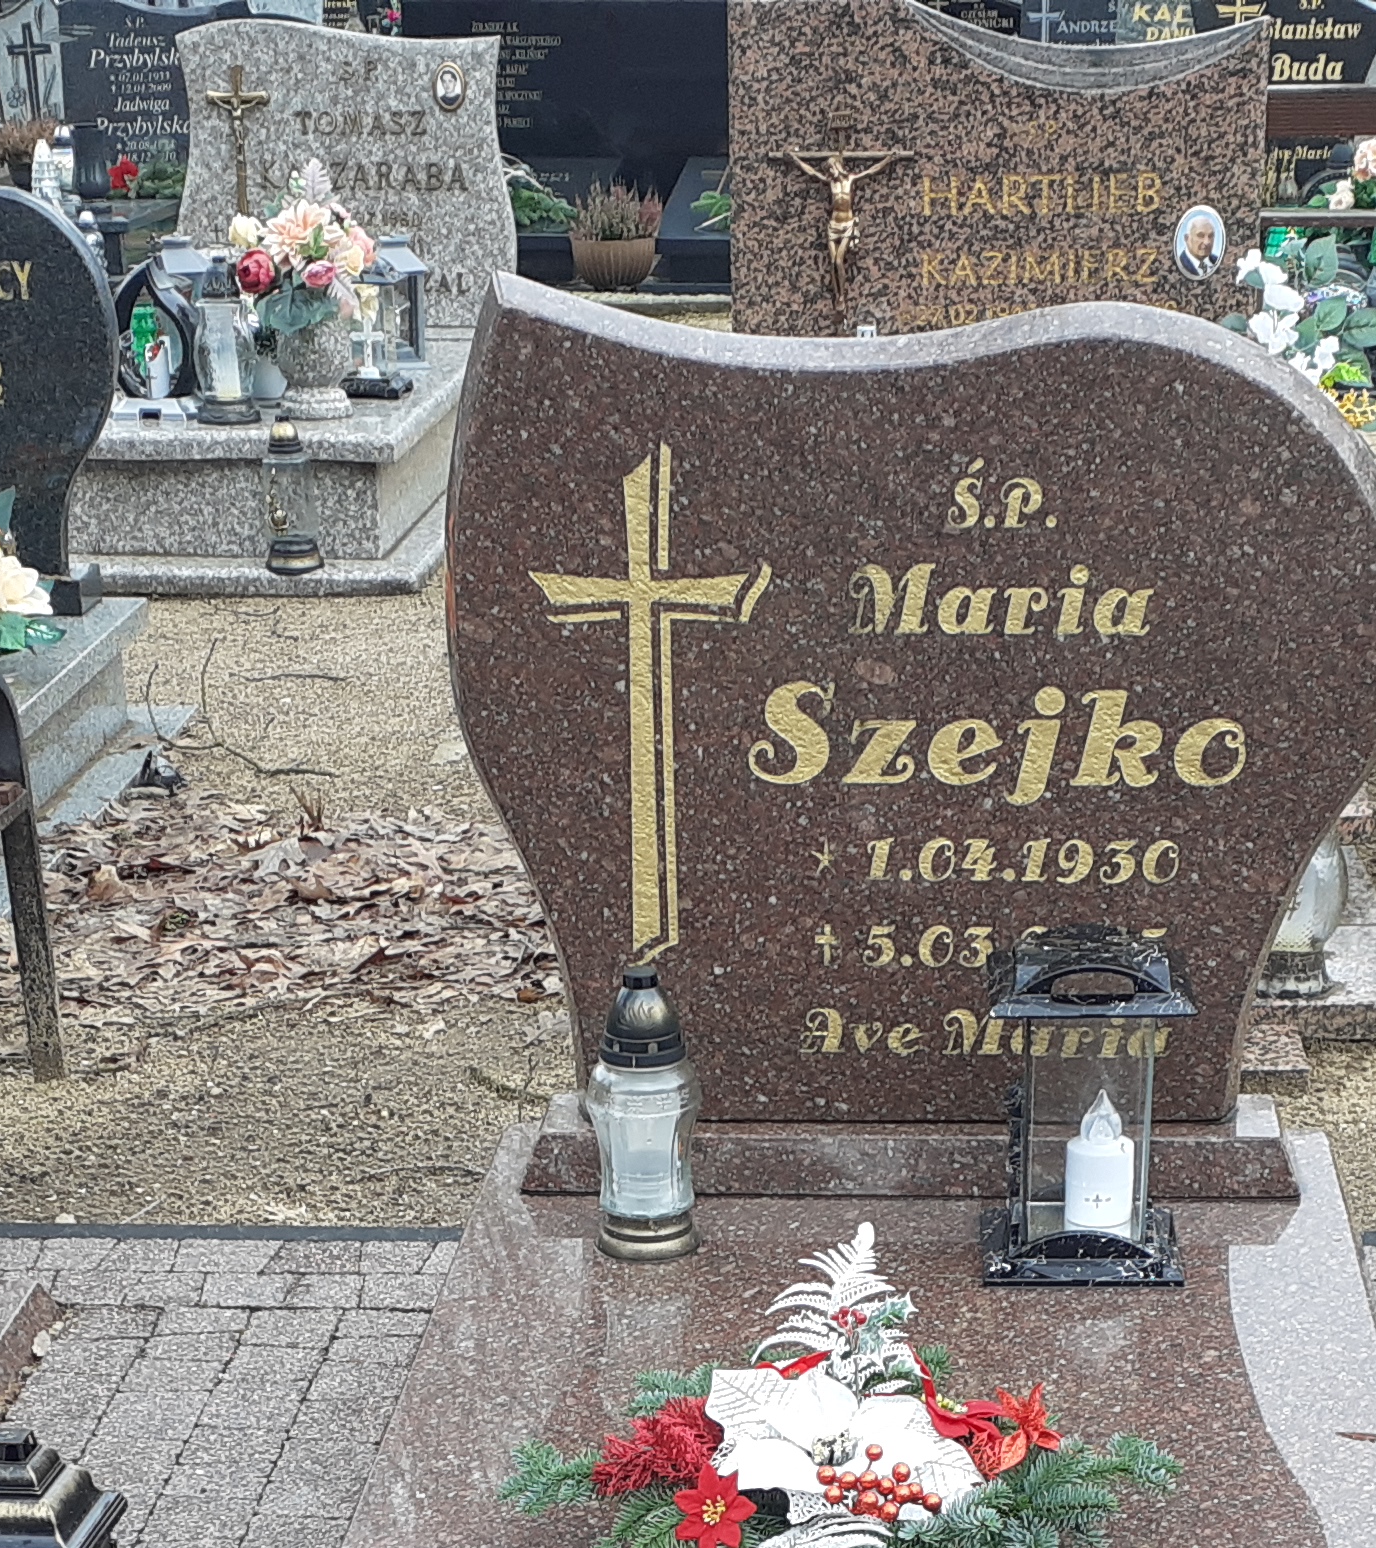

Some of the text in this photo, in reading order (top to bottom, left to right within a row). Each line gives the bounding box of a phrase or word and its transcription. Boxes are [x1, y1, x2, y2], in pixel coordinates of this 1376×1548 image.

[105, 31, 167, 49] Tadeusz
[1269, 16, 1363, 40] tanisław
[87, 47, 181, 72] Przybylsk
[1271, 52, 1345, 82] Buda
[112, 95, 171, 114] Jadwiga
[292, 109, 428, 137] TOMASZ
[260, 160, 470, 192] KZARABA
[922, 171, 1164, 216] HARTLIEB
[922, 247, 1161, 287] KAZIMIERZ
[946, 457, 1058, 529] Ś.P.
[848, 562, 1155, 638] Maria
[748, 679, 1247, 807] Szejko
[867, 836, 1181, 885] 1.04.1930
[800, 1006, 1174, 1060] Ave Maria
